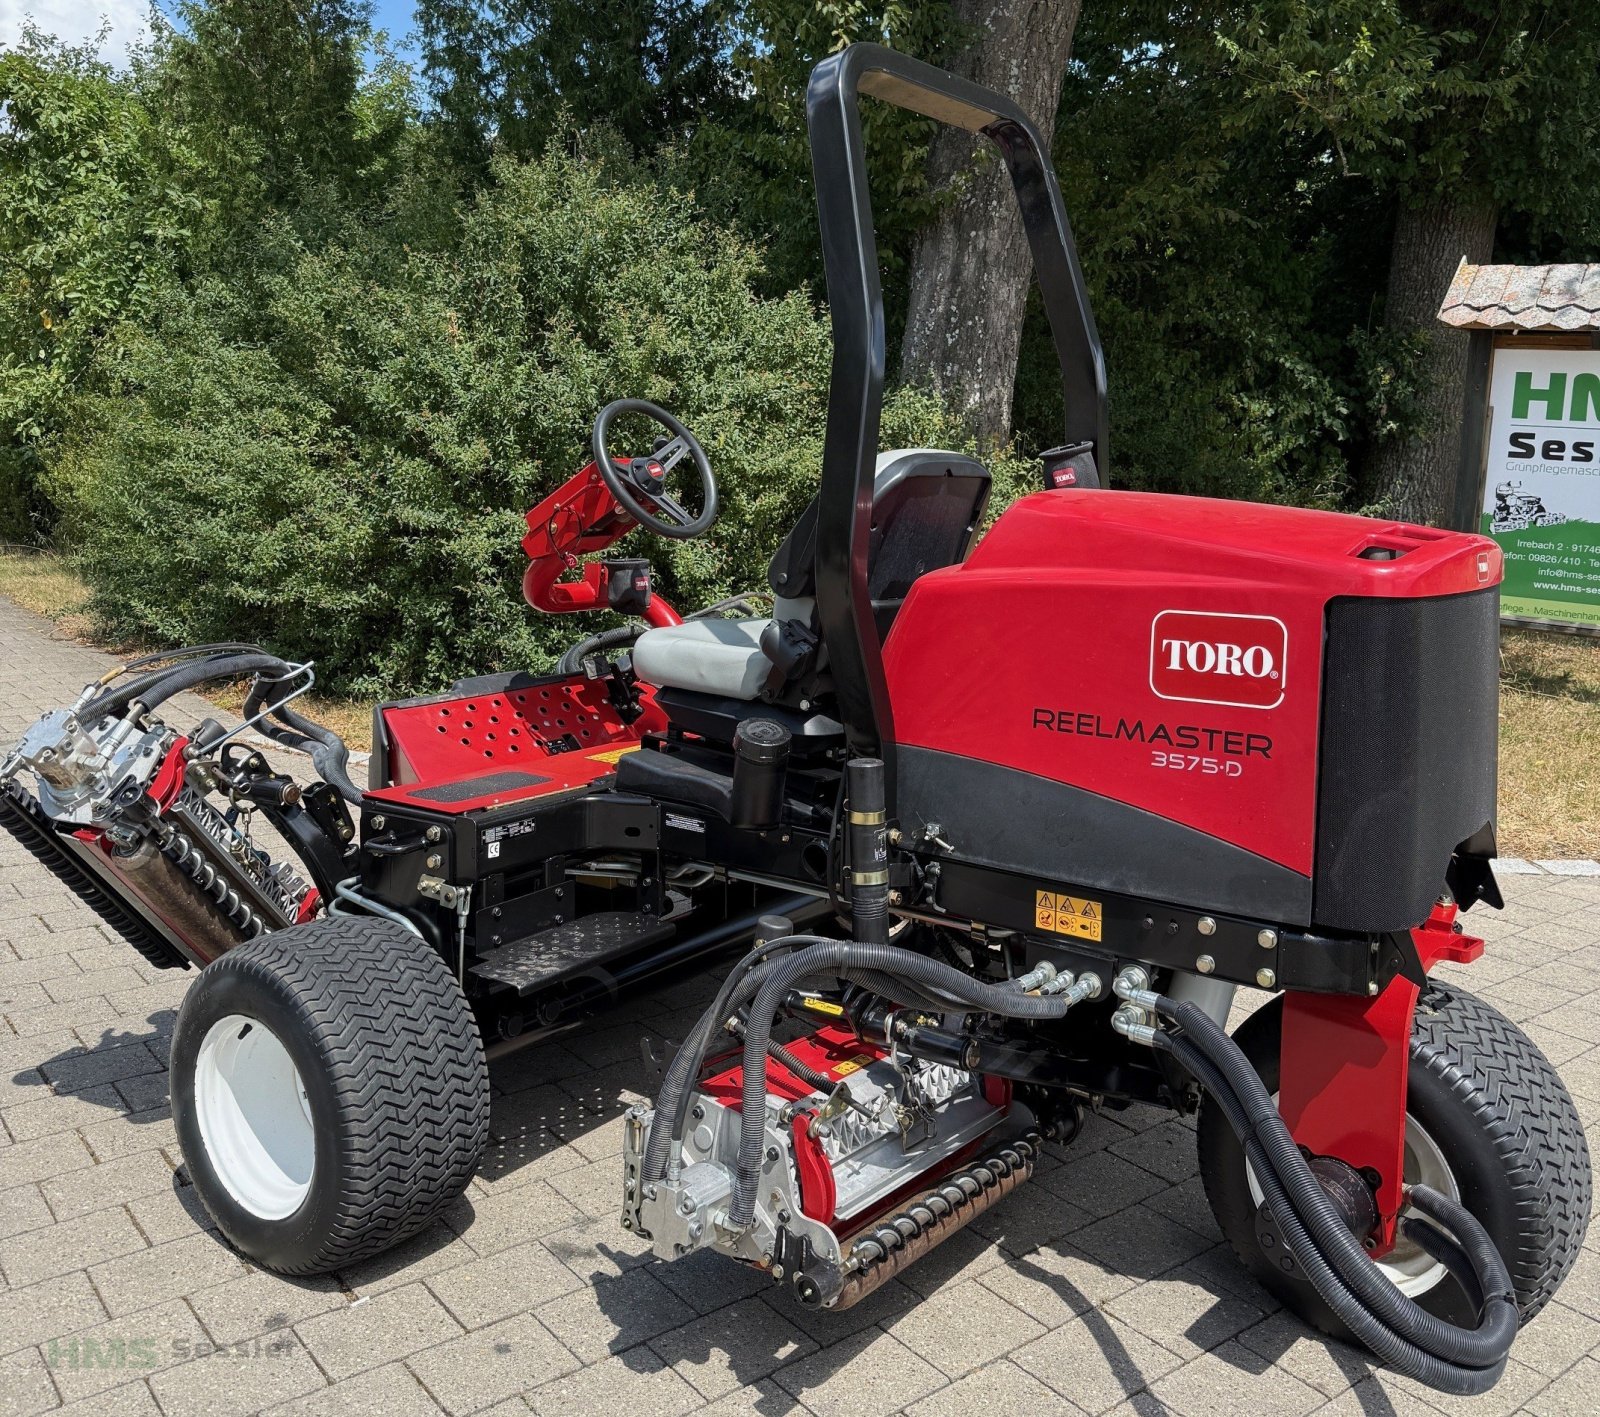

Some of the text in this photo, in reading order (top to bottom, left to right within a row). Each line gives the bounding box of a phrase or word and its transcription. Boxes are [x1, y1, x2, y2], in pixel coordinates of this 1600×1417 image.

[1507, 431, 1600, 463] Ses
[1505, 461, 1600, 477] Grünpflegemasc
[1517, 539, 1600, 554] Irrebach 2 91746
[1503, 551, 1526, 561] efon:
[1528, 553, 1581, 566] 09826/410
[1032, 708, 1274, 759] REELMASTER
